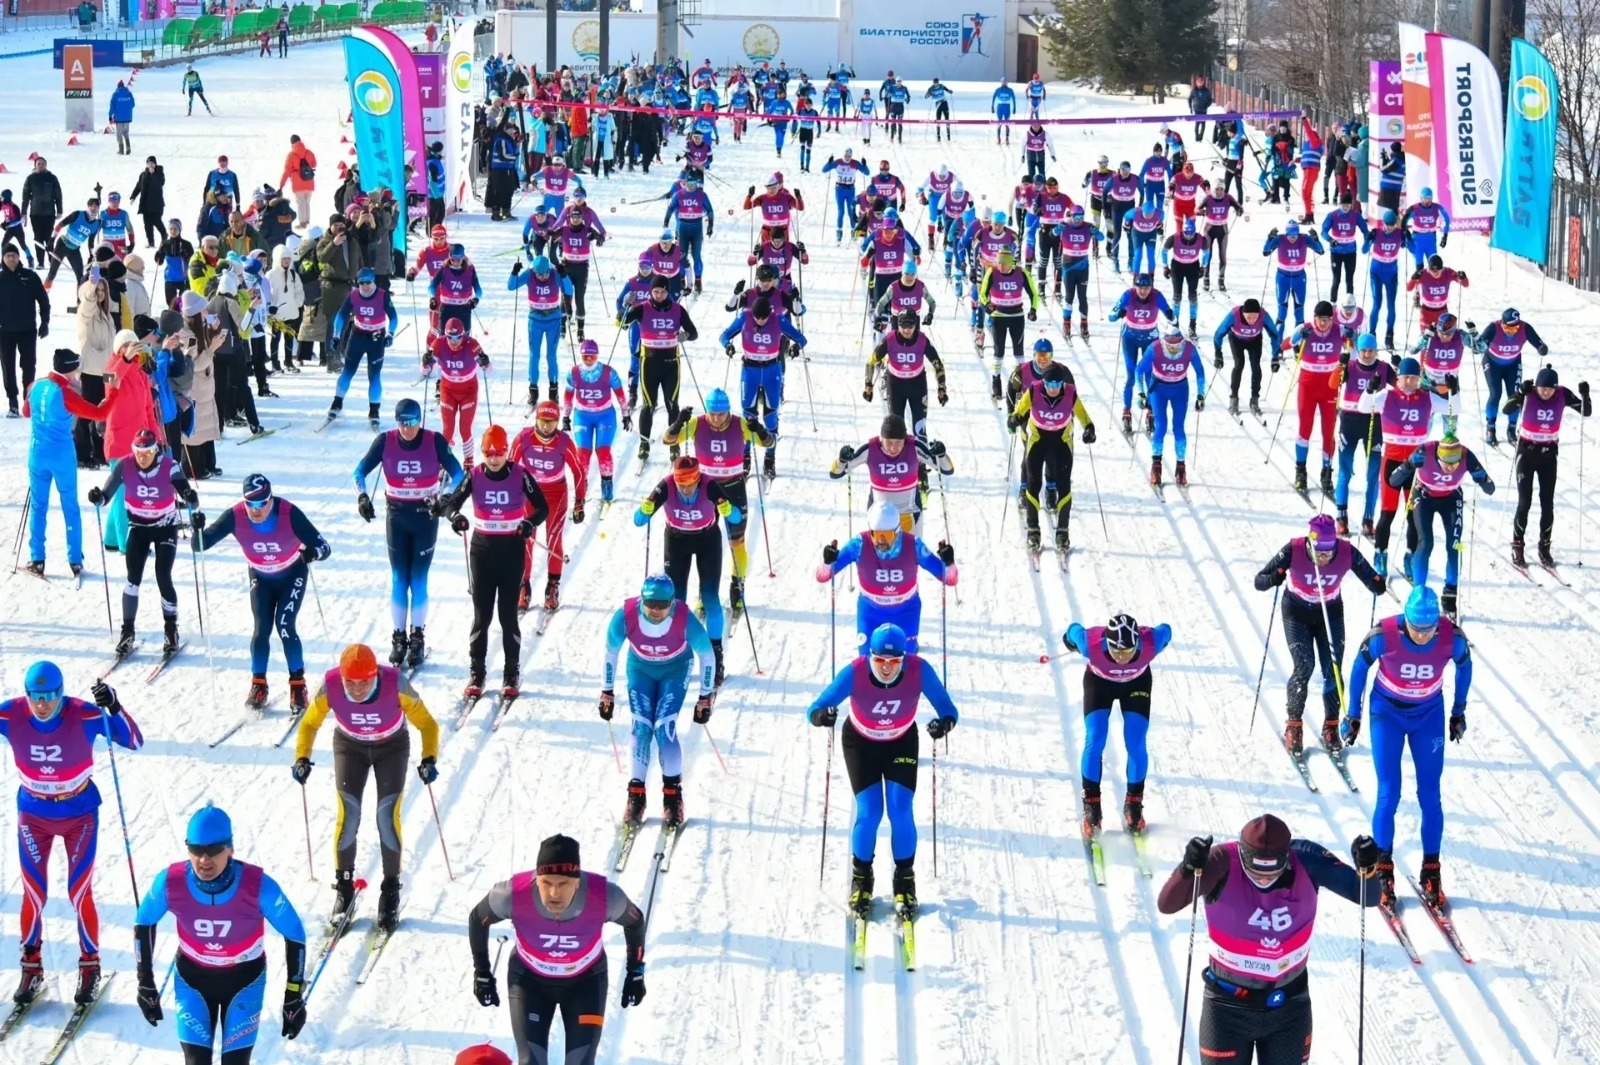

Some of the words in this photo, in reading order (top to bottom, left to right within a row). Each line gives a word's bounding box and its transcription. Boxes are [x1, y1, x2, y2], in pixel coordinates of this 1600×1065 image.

[860, 29, 959, 37] БИАТЛОНИСТОВ
[910, 36, 959, 45] РОССИИ
[838, 176, 852, 184] 344
[78, 225, 91, 236] 312
[451, 281, 462, 289] 74
[536, 286, 550, 295] 116
[999, 282, 1017, 290] 105
[1429, 286, 1446, 295] 153
[899, 297, 917, 305] 106
[360, 307, 374, 316] 59
[1134, 310, 1150, 318] 127
[652, 319, 674, 328] 132
[753, 333, 772, 344] 68
[1311, 342, 1333, 352] 102
[897, 353, 916, 362] 90
[1434, 349, 1456, 359] 109
[446, 360, 464, 368] 119
[1161, 364, 1184, 372] 148
[580, 389, 602, 399] 123
[1038, 410, 1064, 420] 140
[1400, 409, 1419, 421] 78
[1537, 410, 1554, 421] 92
[711, 440, 727, 452] 61
[397, 461, 422, 474] 63
[528, 458, 554, 470] 156
[879, 462, 908, 474] 120
[1433, 472, 1452, 481] 70
[137, 485, 159, 497] 82
[485, 491, 509, 504] 50
[674, 509, 703, 520] 138
[1453, 500, 1463, 550] SKALA
[253, 542, 281, 552] 93
[876, 569, 903, 582] 88
[1304, 574, 1338, 584] 147
[281, 578, 304, 639] SKALA
[1400, 664, 1434, 679] 98
[872, 700, 901, 715] 47
[351, 713, 381, 724] 55
[31, 745, 62, 762] 52
[20, 824, 42, 864] RUSSIA
[1248, 906, 1292, 932] 46
[194, 919, 232, 937] 97
[540, 934, 579, 948] 75
[179, 1012, 210, 1042] PERM
